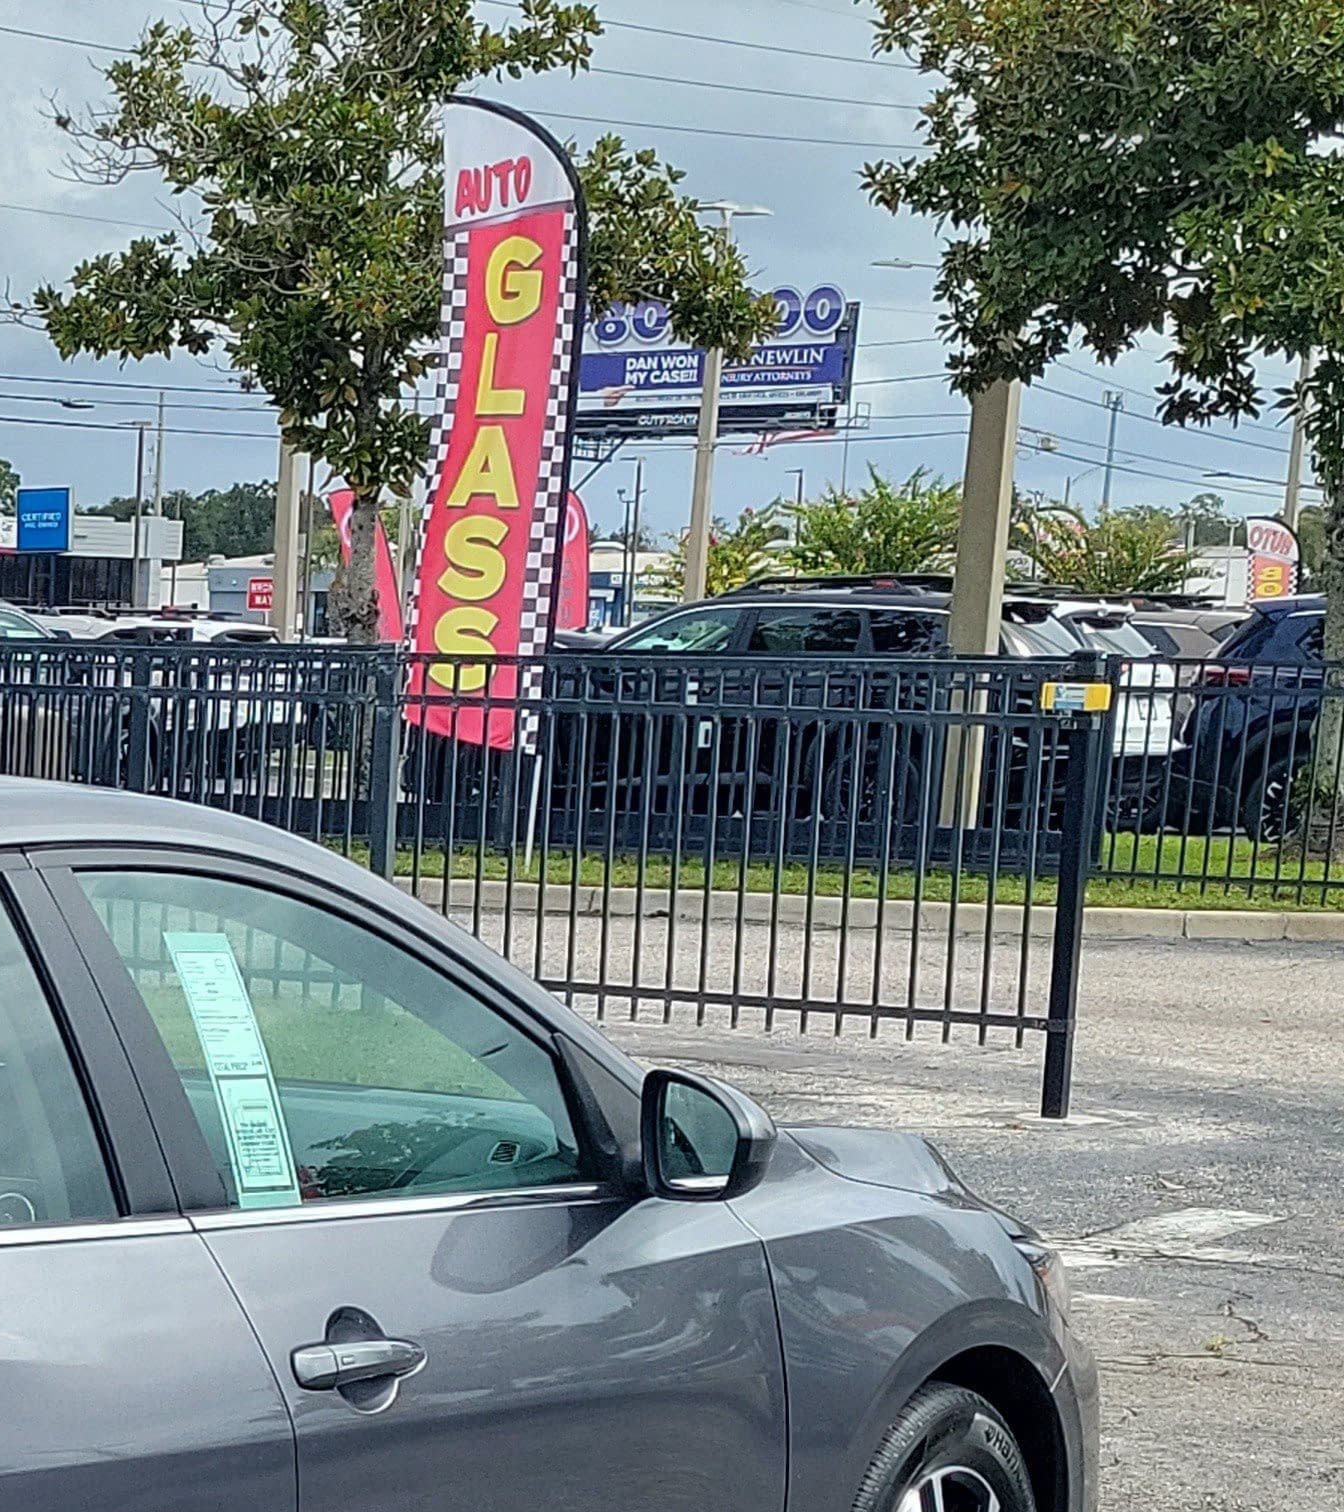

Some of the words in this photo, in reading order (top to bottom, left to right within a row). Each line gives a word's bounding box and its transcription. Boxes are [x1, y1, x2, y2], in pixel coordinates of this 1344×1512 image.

[454, 156, 532, 218] AUTO
[625, 354, 658, 371] DAN
[661, 353, 700, 369] WON
[751, 348, 825, 365] NEWLIN
[625, 371, 648, 385] MY
[721, 373, 753, 383] NJURY
[427, 235, 544, 691] GLASS
